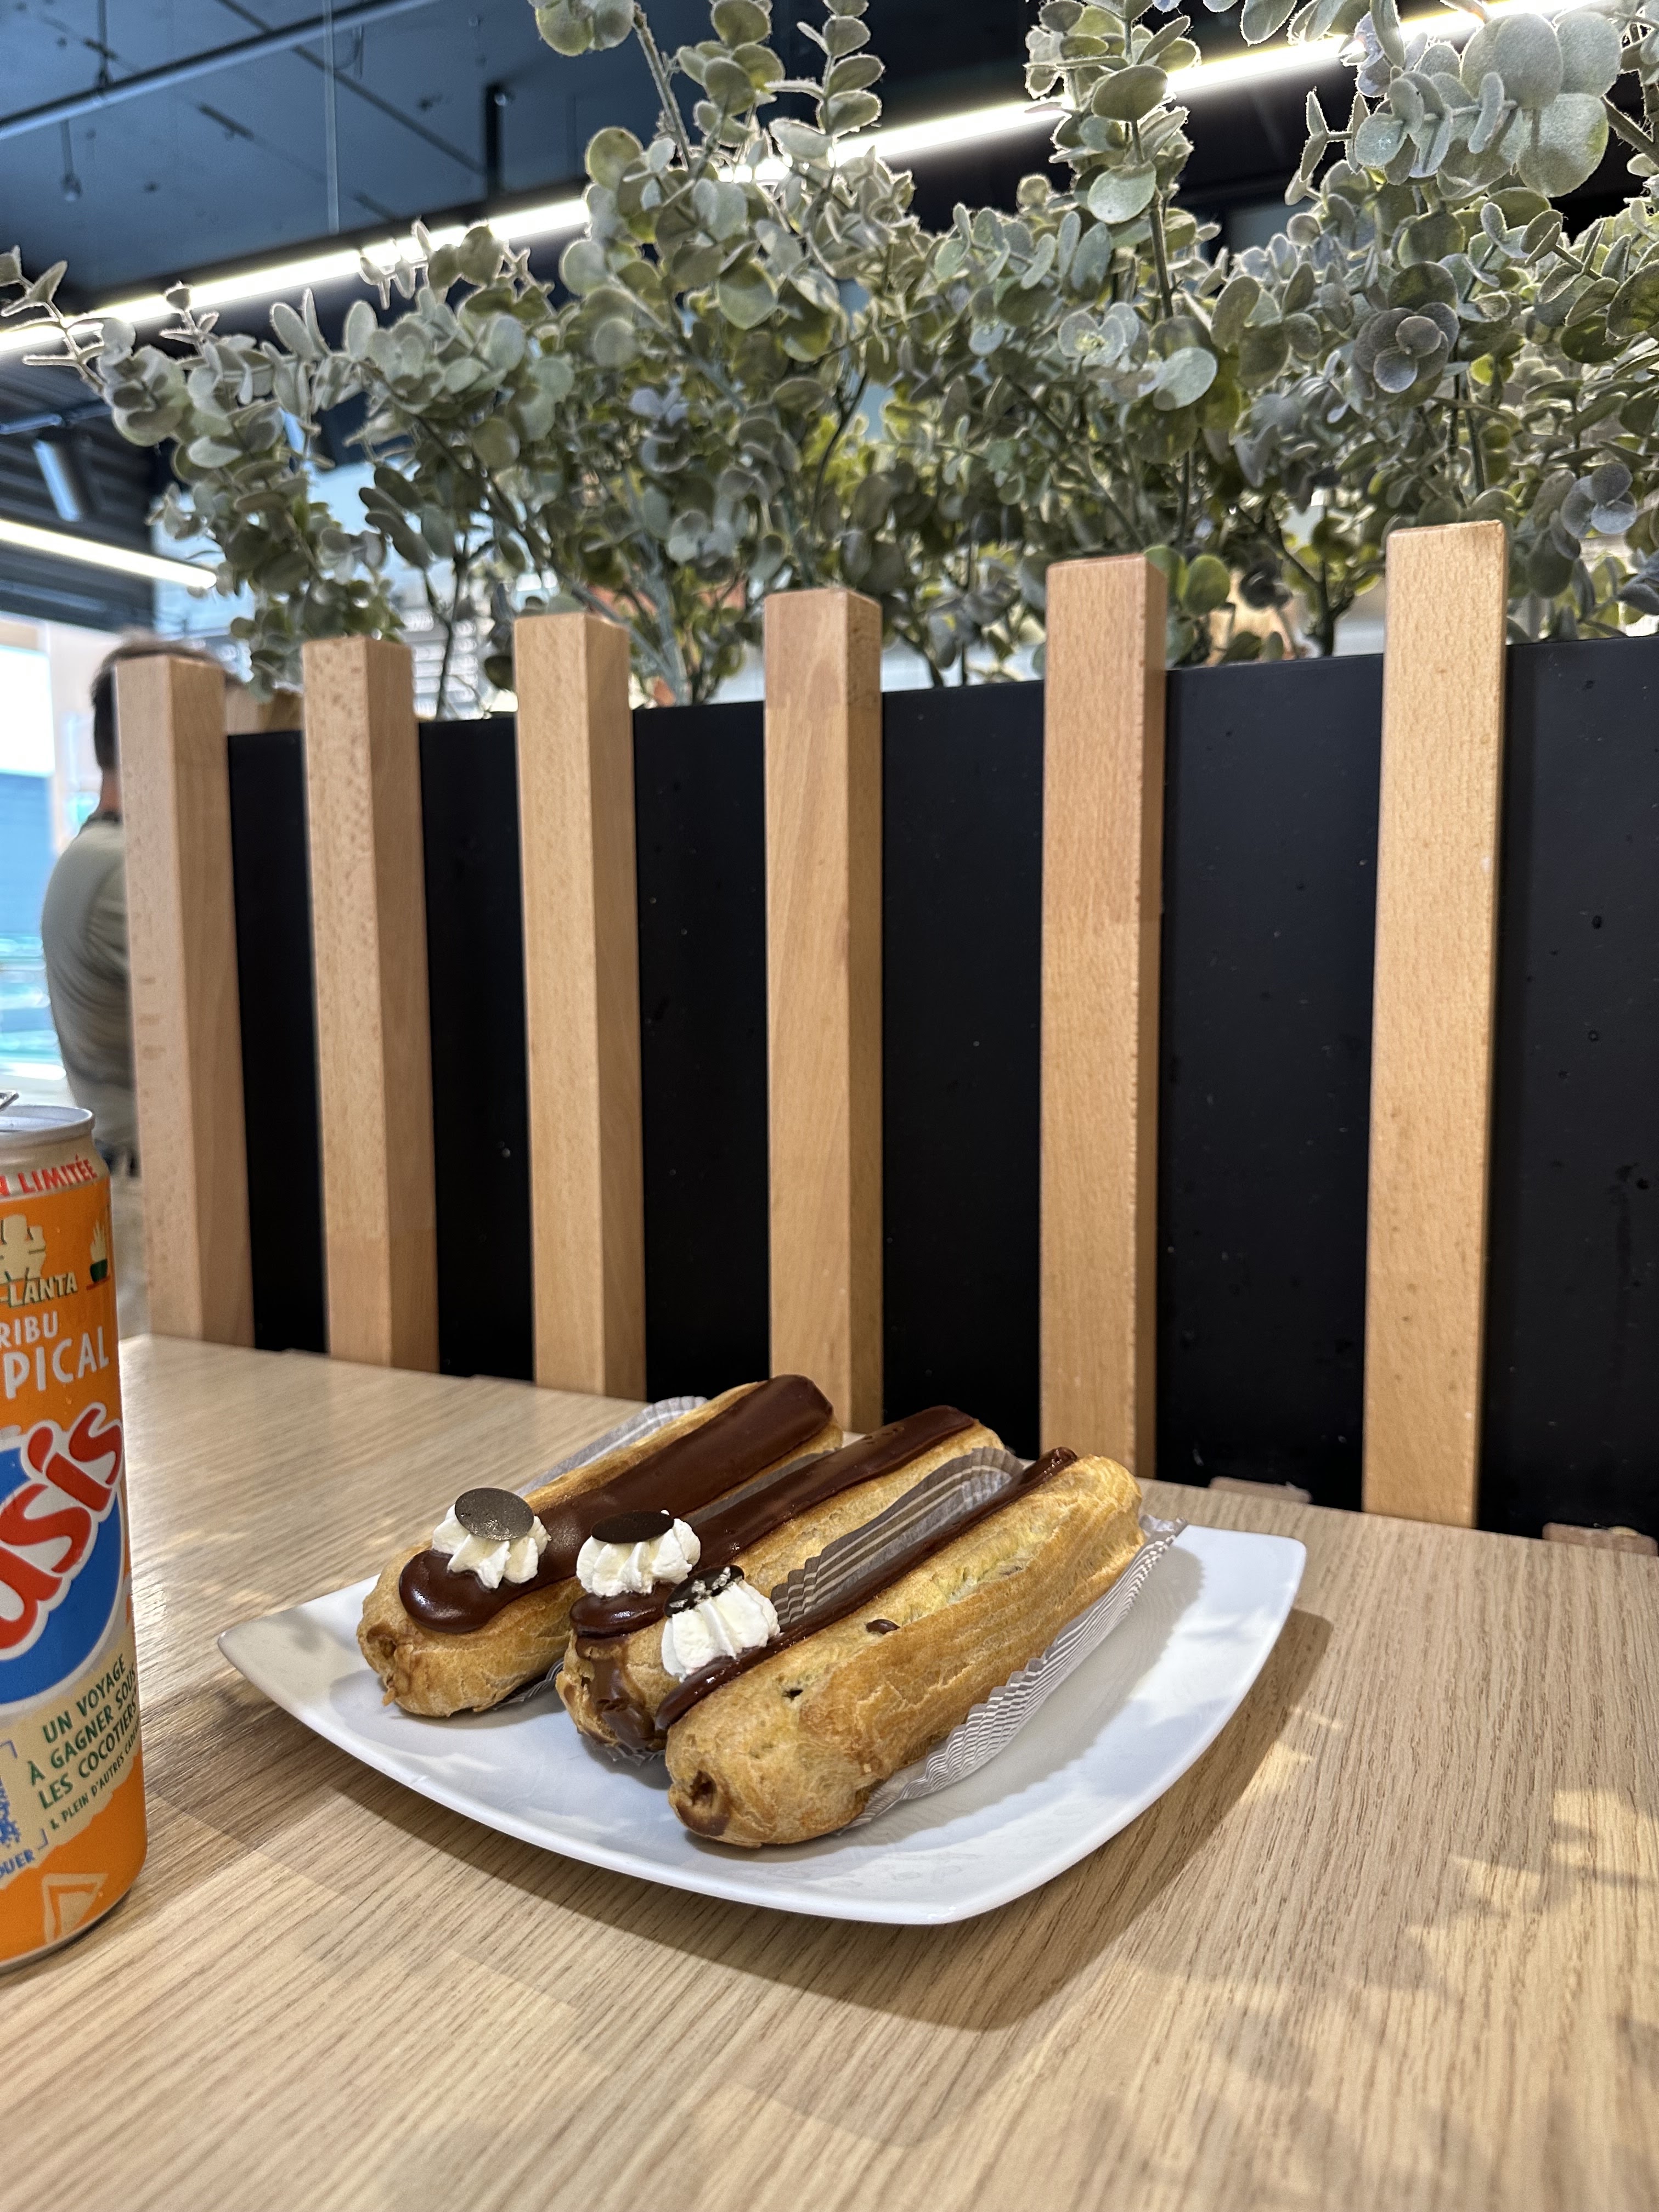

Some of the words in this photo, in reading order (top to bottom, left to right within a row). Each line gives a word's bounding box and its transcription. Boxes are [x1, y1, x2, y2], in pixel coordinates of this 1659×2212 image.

[18, 1154, 98, 1194] LIMITÉE
[3, 1325, 110, 1400] PICAL
[42, 1709, 72, 1743] UN
[76, 1653, 126, 1717] VOYAGE
[51, 1705, 114, 1769] GAGNER
[116, 1662, 136, 1711] SOUS
[38, 1773, 74, 1809] LES
[61, 1792, 89, 1822] PLEIN
[91, 1752, 125, 1797] D'AUTRES
